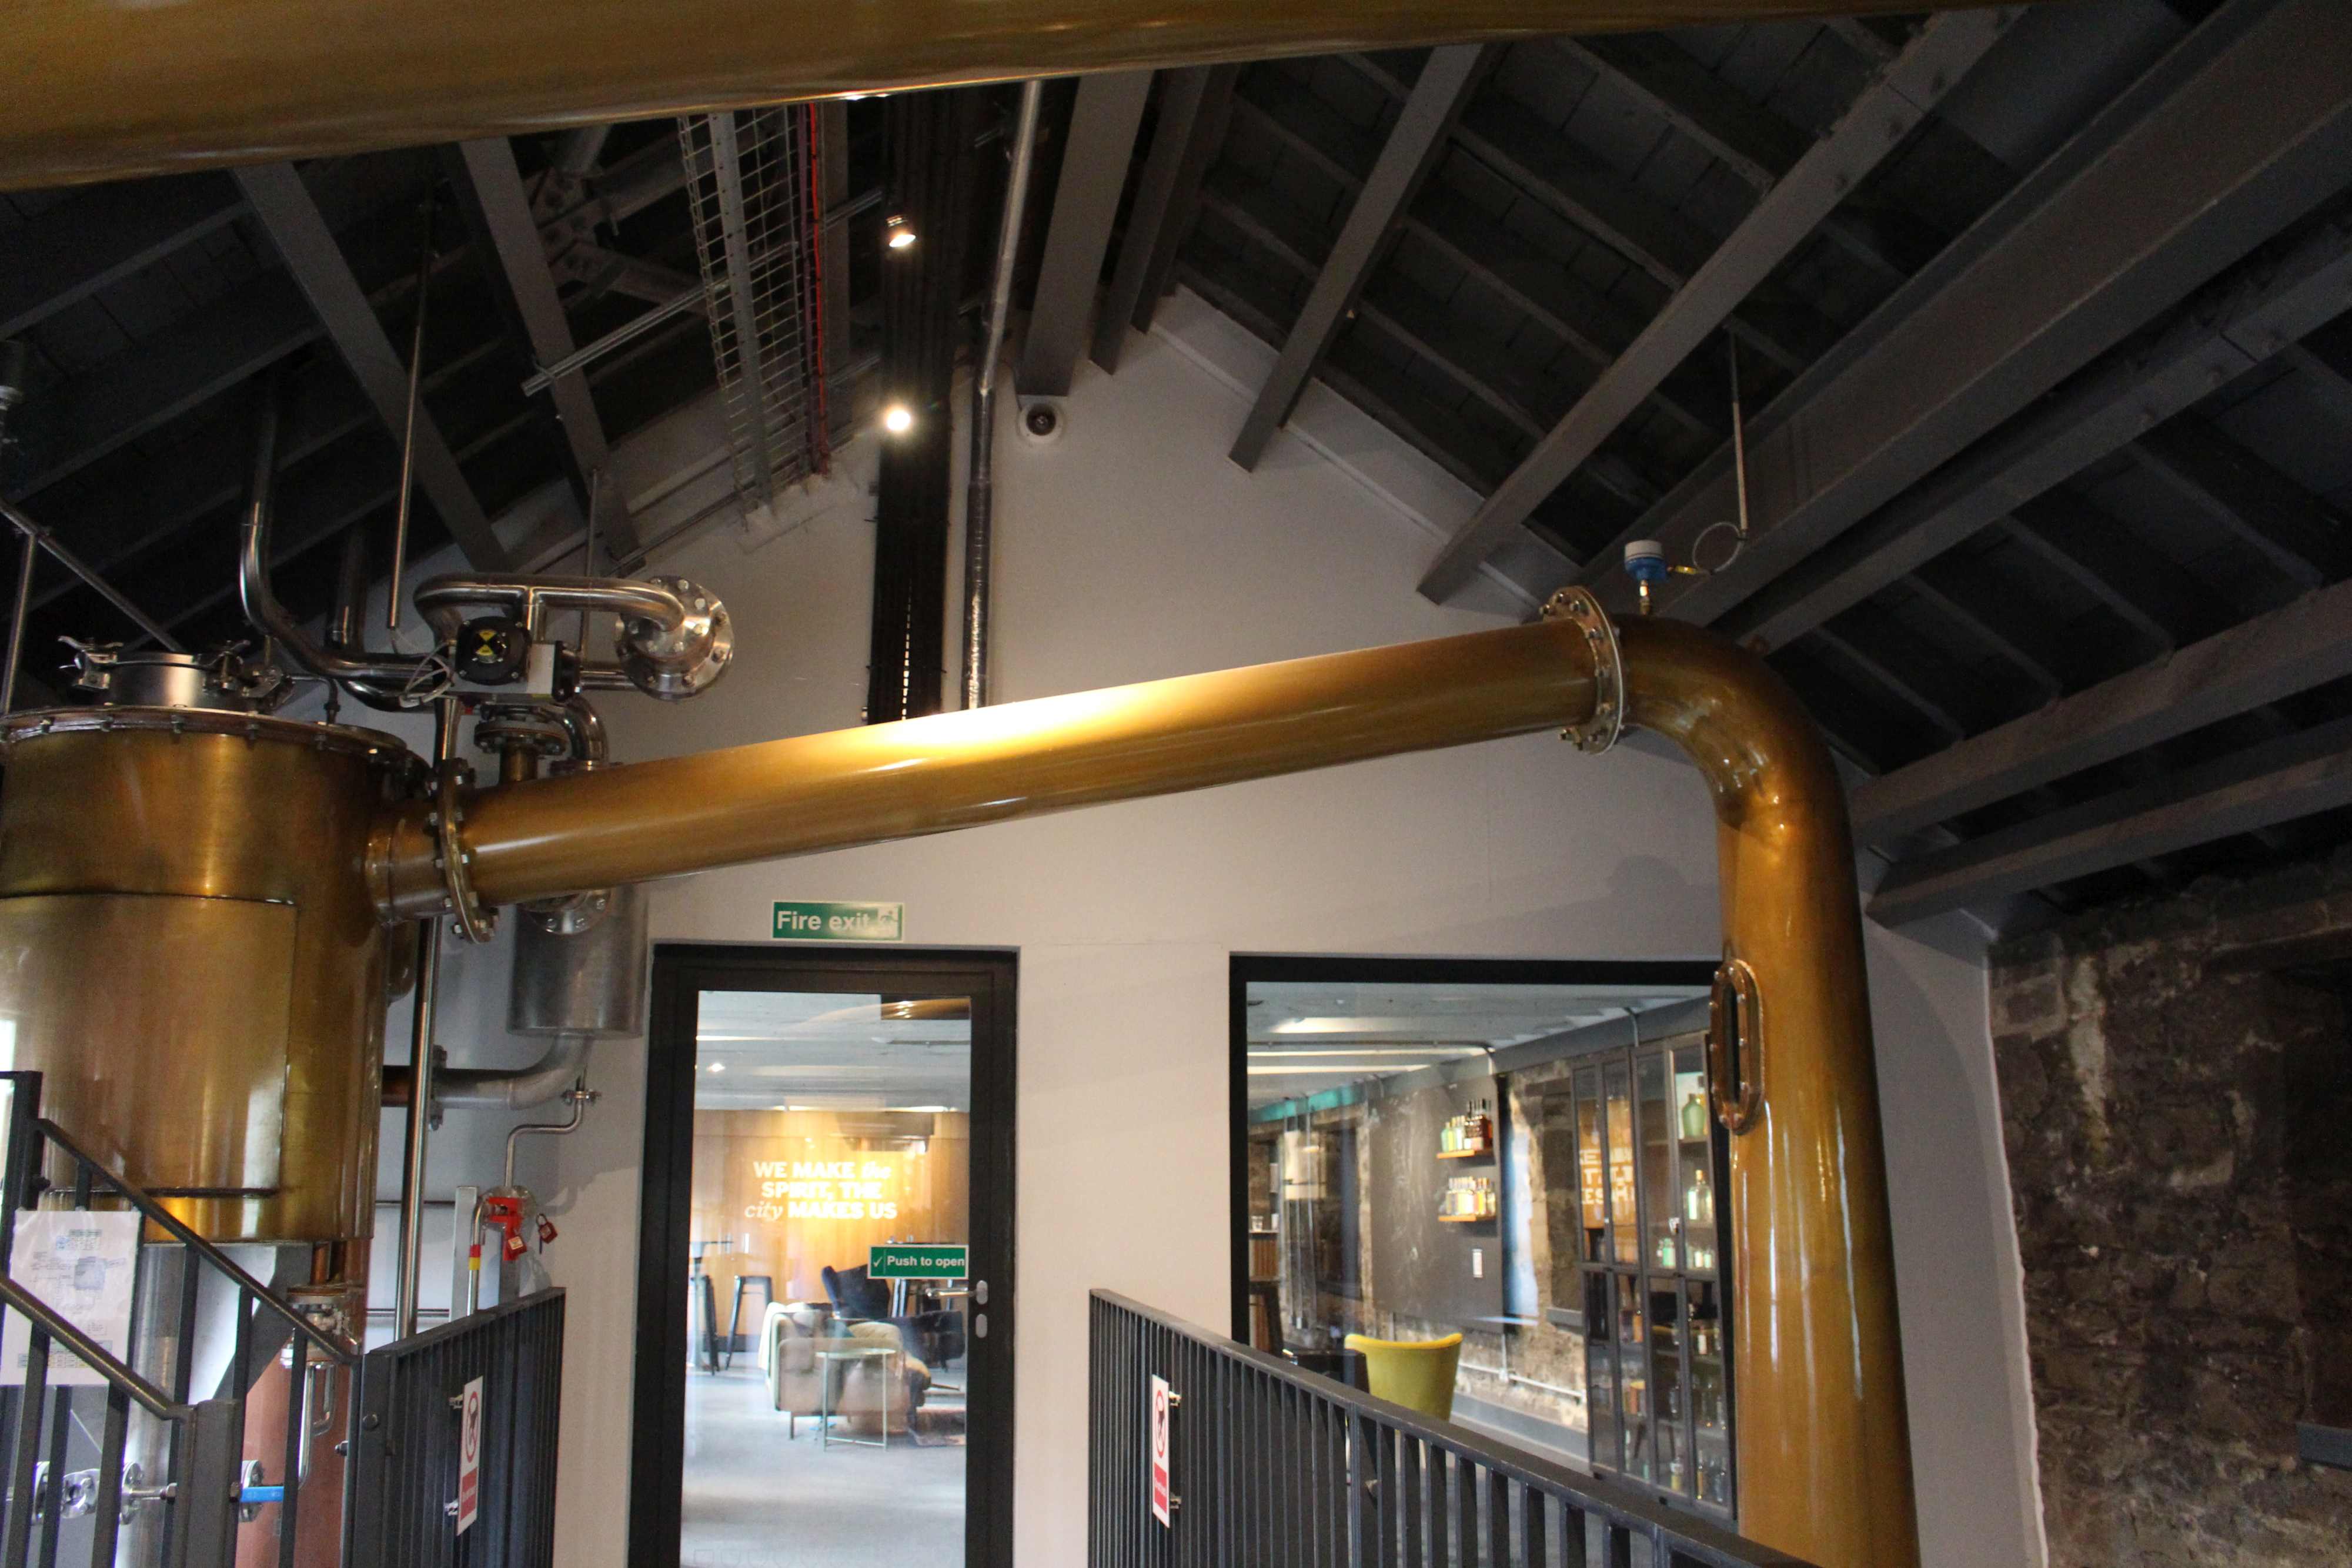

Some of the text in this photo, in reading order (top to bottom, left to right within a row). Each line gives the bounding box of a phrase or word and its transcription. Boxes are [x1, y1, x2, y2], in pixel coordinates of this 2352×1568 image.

[777, 910, 870, 931] Fire exit
[753, 1161, 892, 1179] WE MAKE the
[761, 1181, 882, 1201] SPIRIT, THE
[744, 1201, 898, 1221] city MAKES US
[887, 1255, 965, 1269] Push to open
